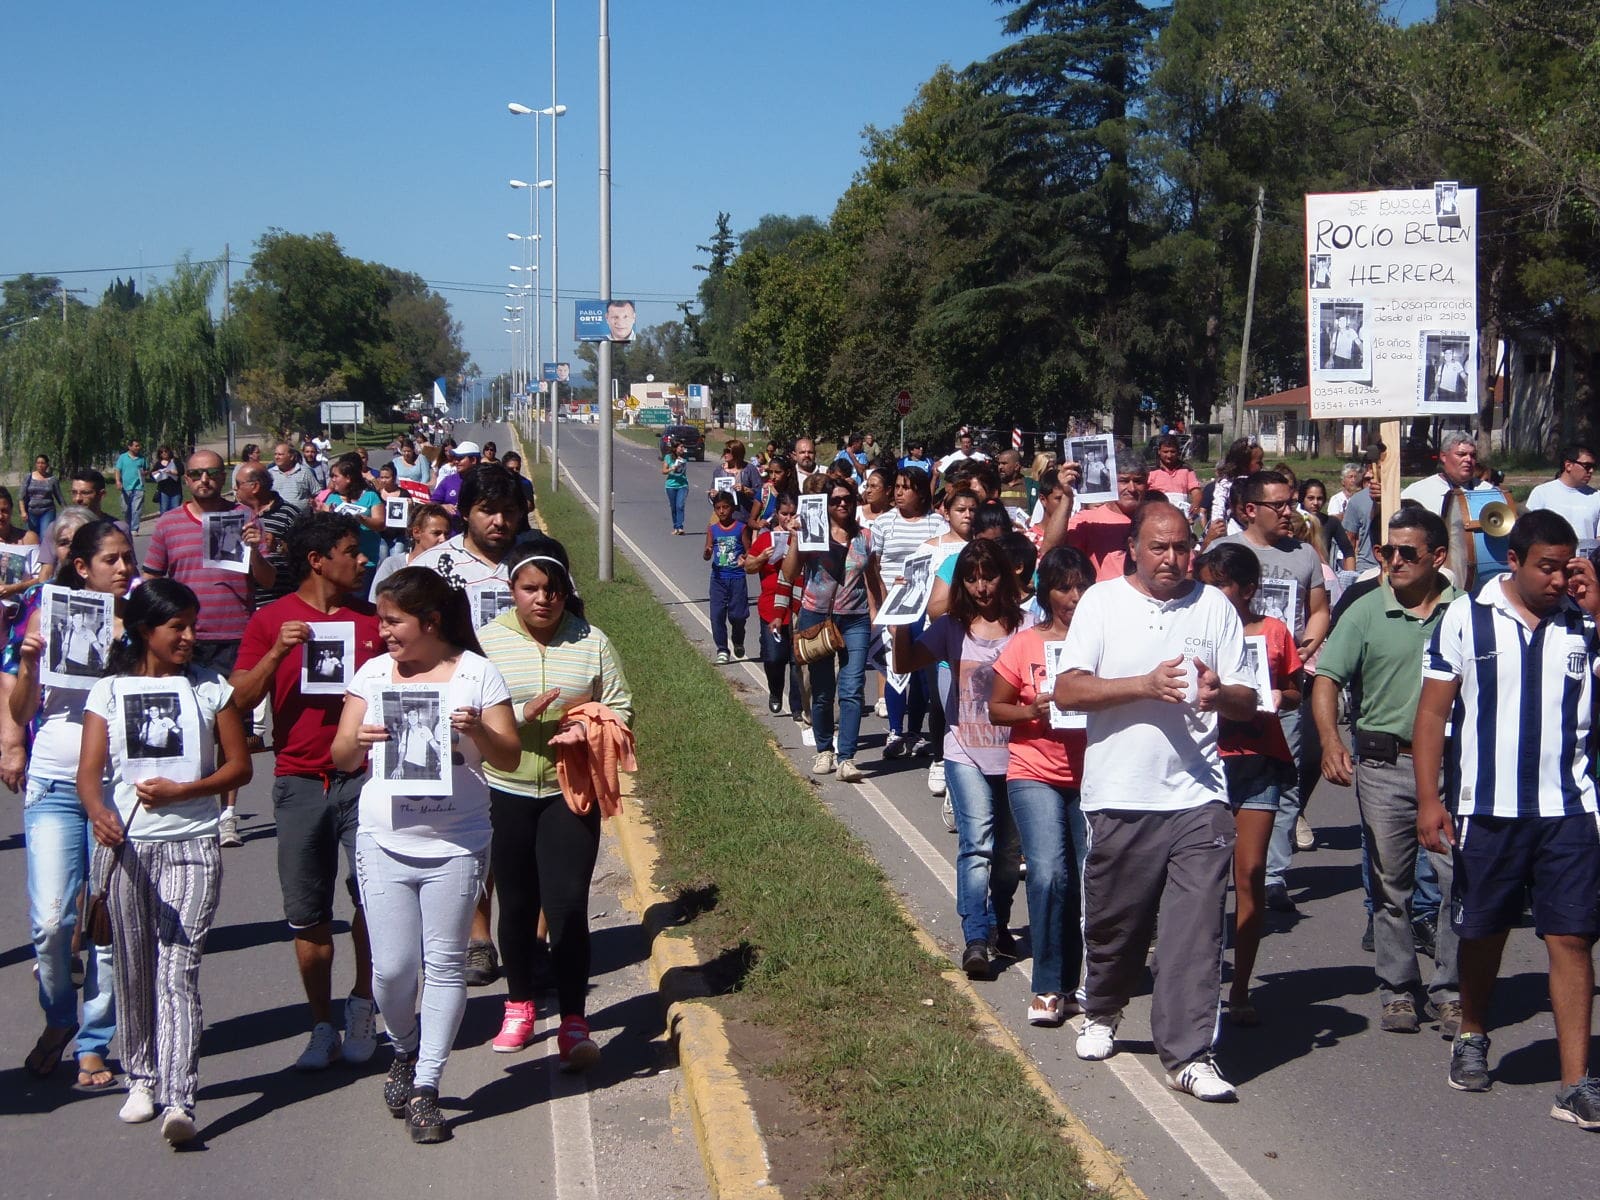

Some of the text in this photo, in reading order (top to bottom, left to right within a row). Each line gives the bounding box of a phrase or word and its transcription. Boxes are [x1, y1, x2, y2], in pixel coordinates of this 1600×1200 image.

[1348, 198, 1432, 212] SE BUSCA
[1374, 312, 1403, 322] desde
[1375, 352, 1413, 361] de edad
